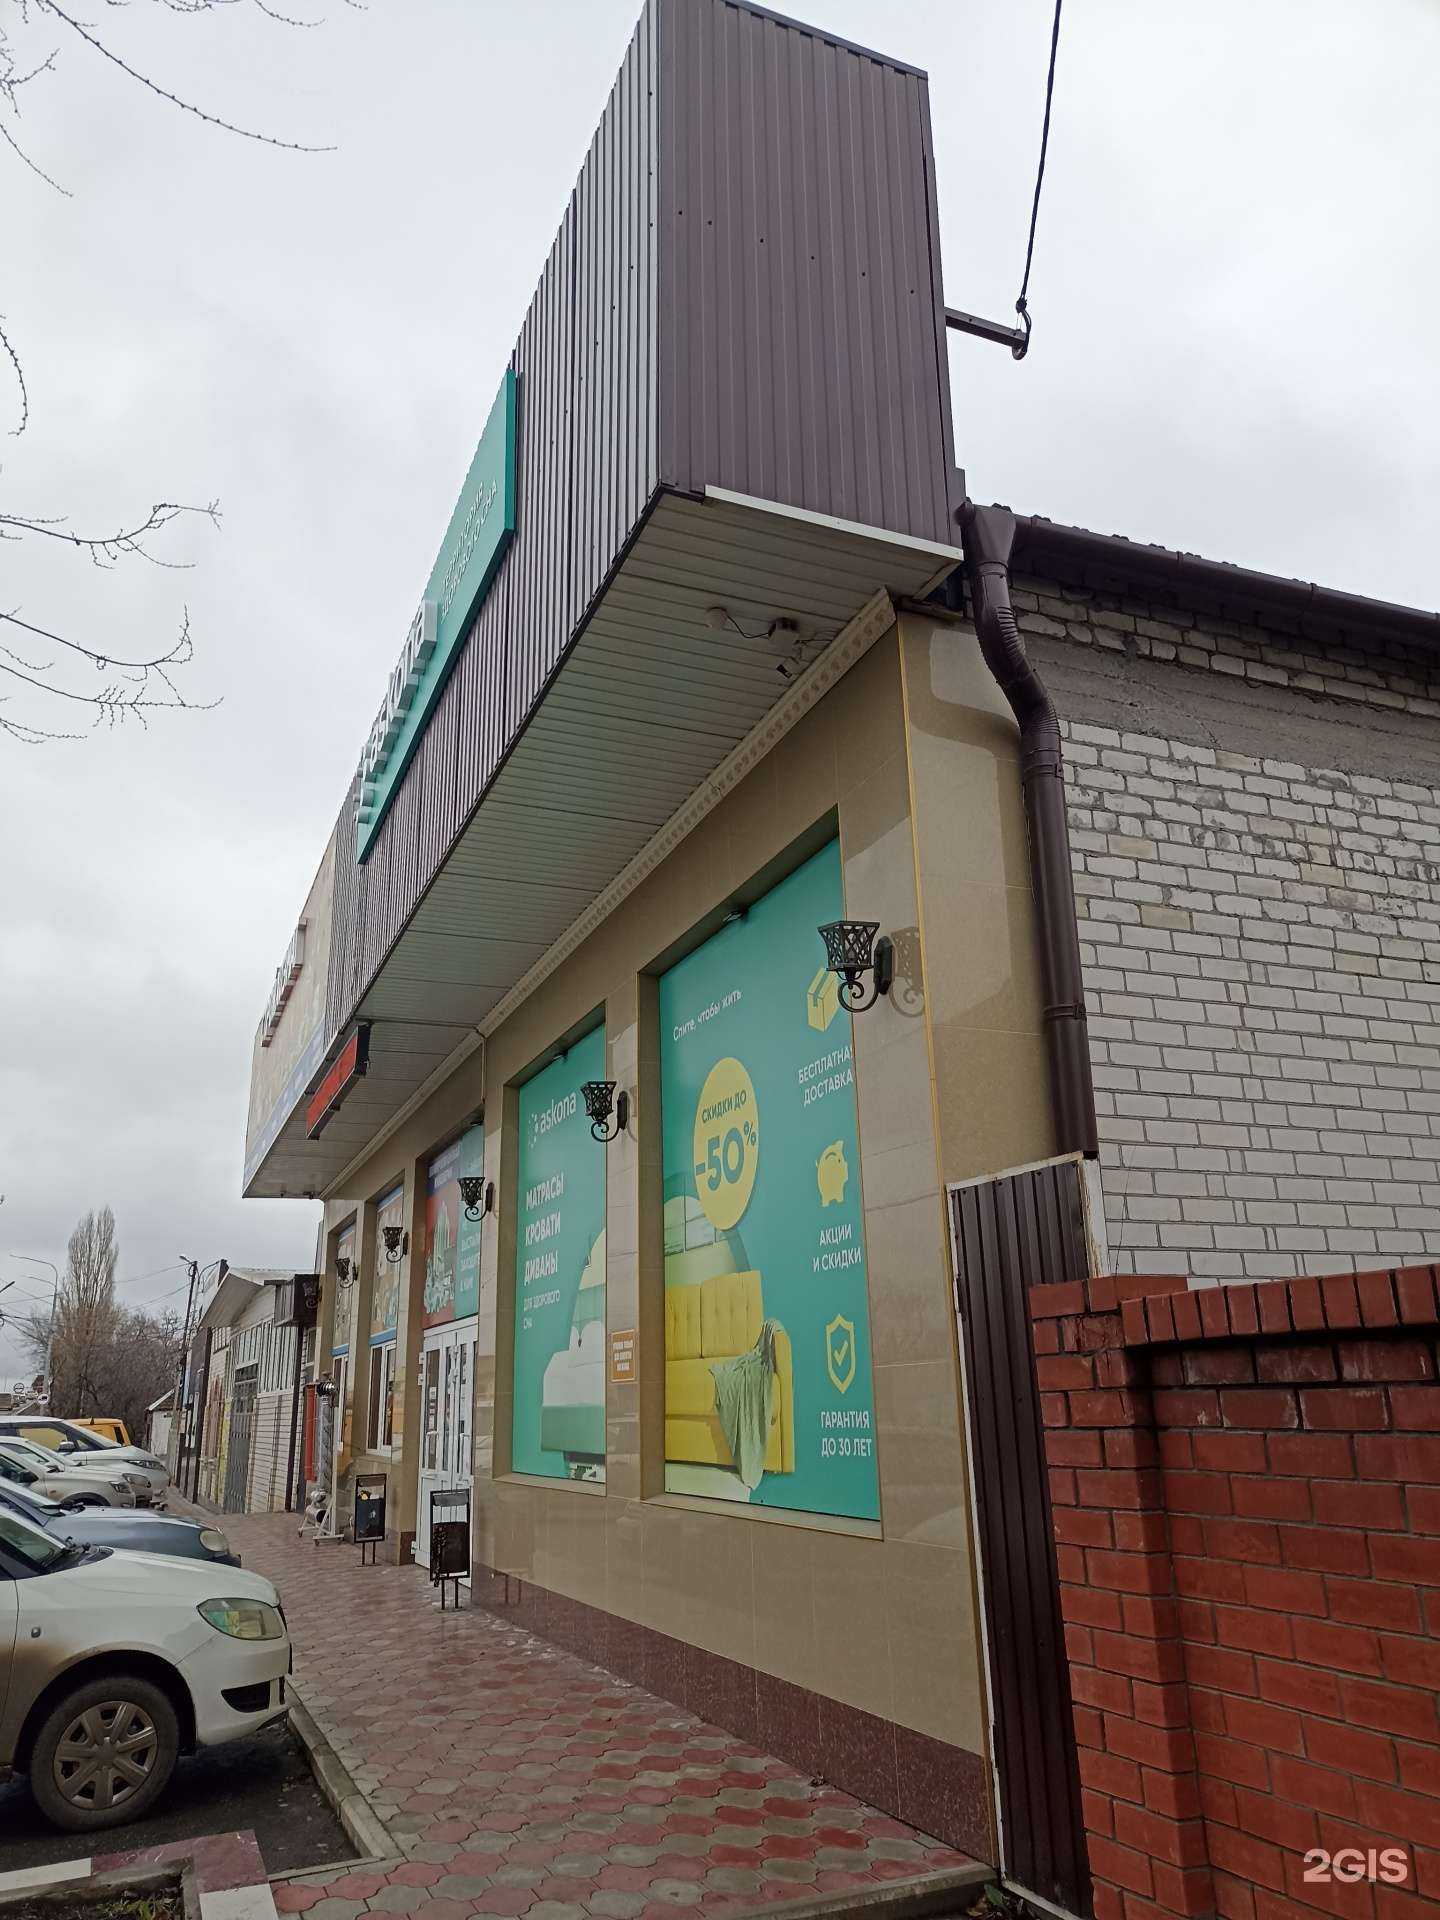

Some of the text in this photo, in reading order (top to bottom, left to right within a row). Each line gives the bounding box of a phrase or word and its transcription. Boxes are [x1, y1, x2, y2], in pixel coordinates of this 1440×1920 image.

[673, 989, 742, 1041] Спите, чтобы жить
[702, 1089, 747, 1124] СКИДКИ ДО
[804, 1069, 854, 1108] ДОСТАВКА
[540, 1091, 577, 1134] askona
[695, 1120, 757, 1191] -50%
[526, 1171, 564, 1211] МАТРАСЫ
[525, 1209, 561, 1247] КРОВАТИ
[819, 1223, 852, 1246] АКЦИИ
[524, 1251, 558, 1287] ДИВАНЫ
[812, 1247, 861, 1273] И СКИДКИ
[820, 1410, 870, 1429] ГАРАНТИЯ
[821, 1437, 872, 1458] ДО 30 ЛЕТ
